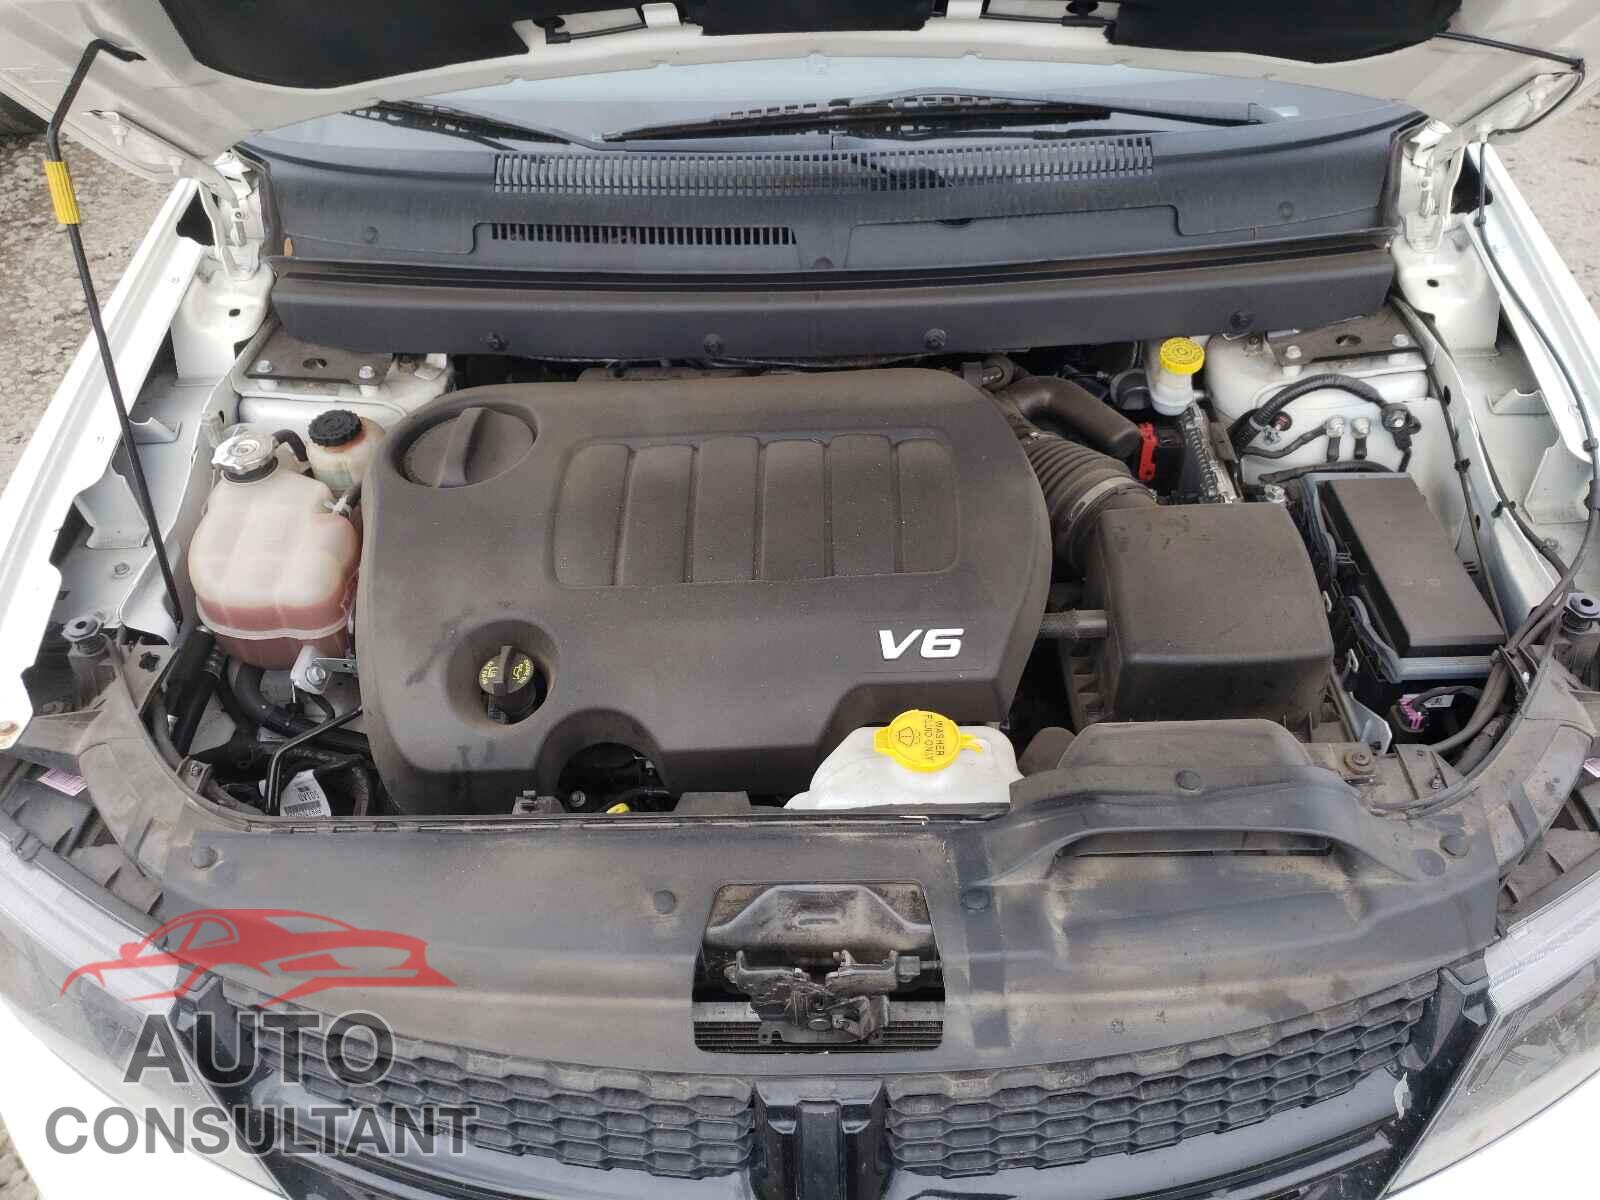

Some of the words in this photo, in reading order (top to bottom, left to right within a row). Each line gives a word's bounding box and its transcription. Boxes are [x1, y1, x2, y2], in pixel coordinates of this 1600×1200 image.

[879, 628, 964, 659] V6
[924, 713, 933, 738] FLUID
[935, 720, 945, 756] WASHER
[924, 739, 934, 761] ONLY
